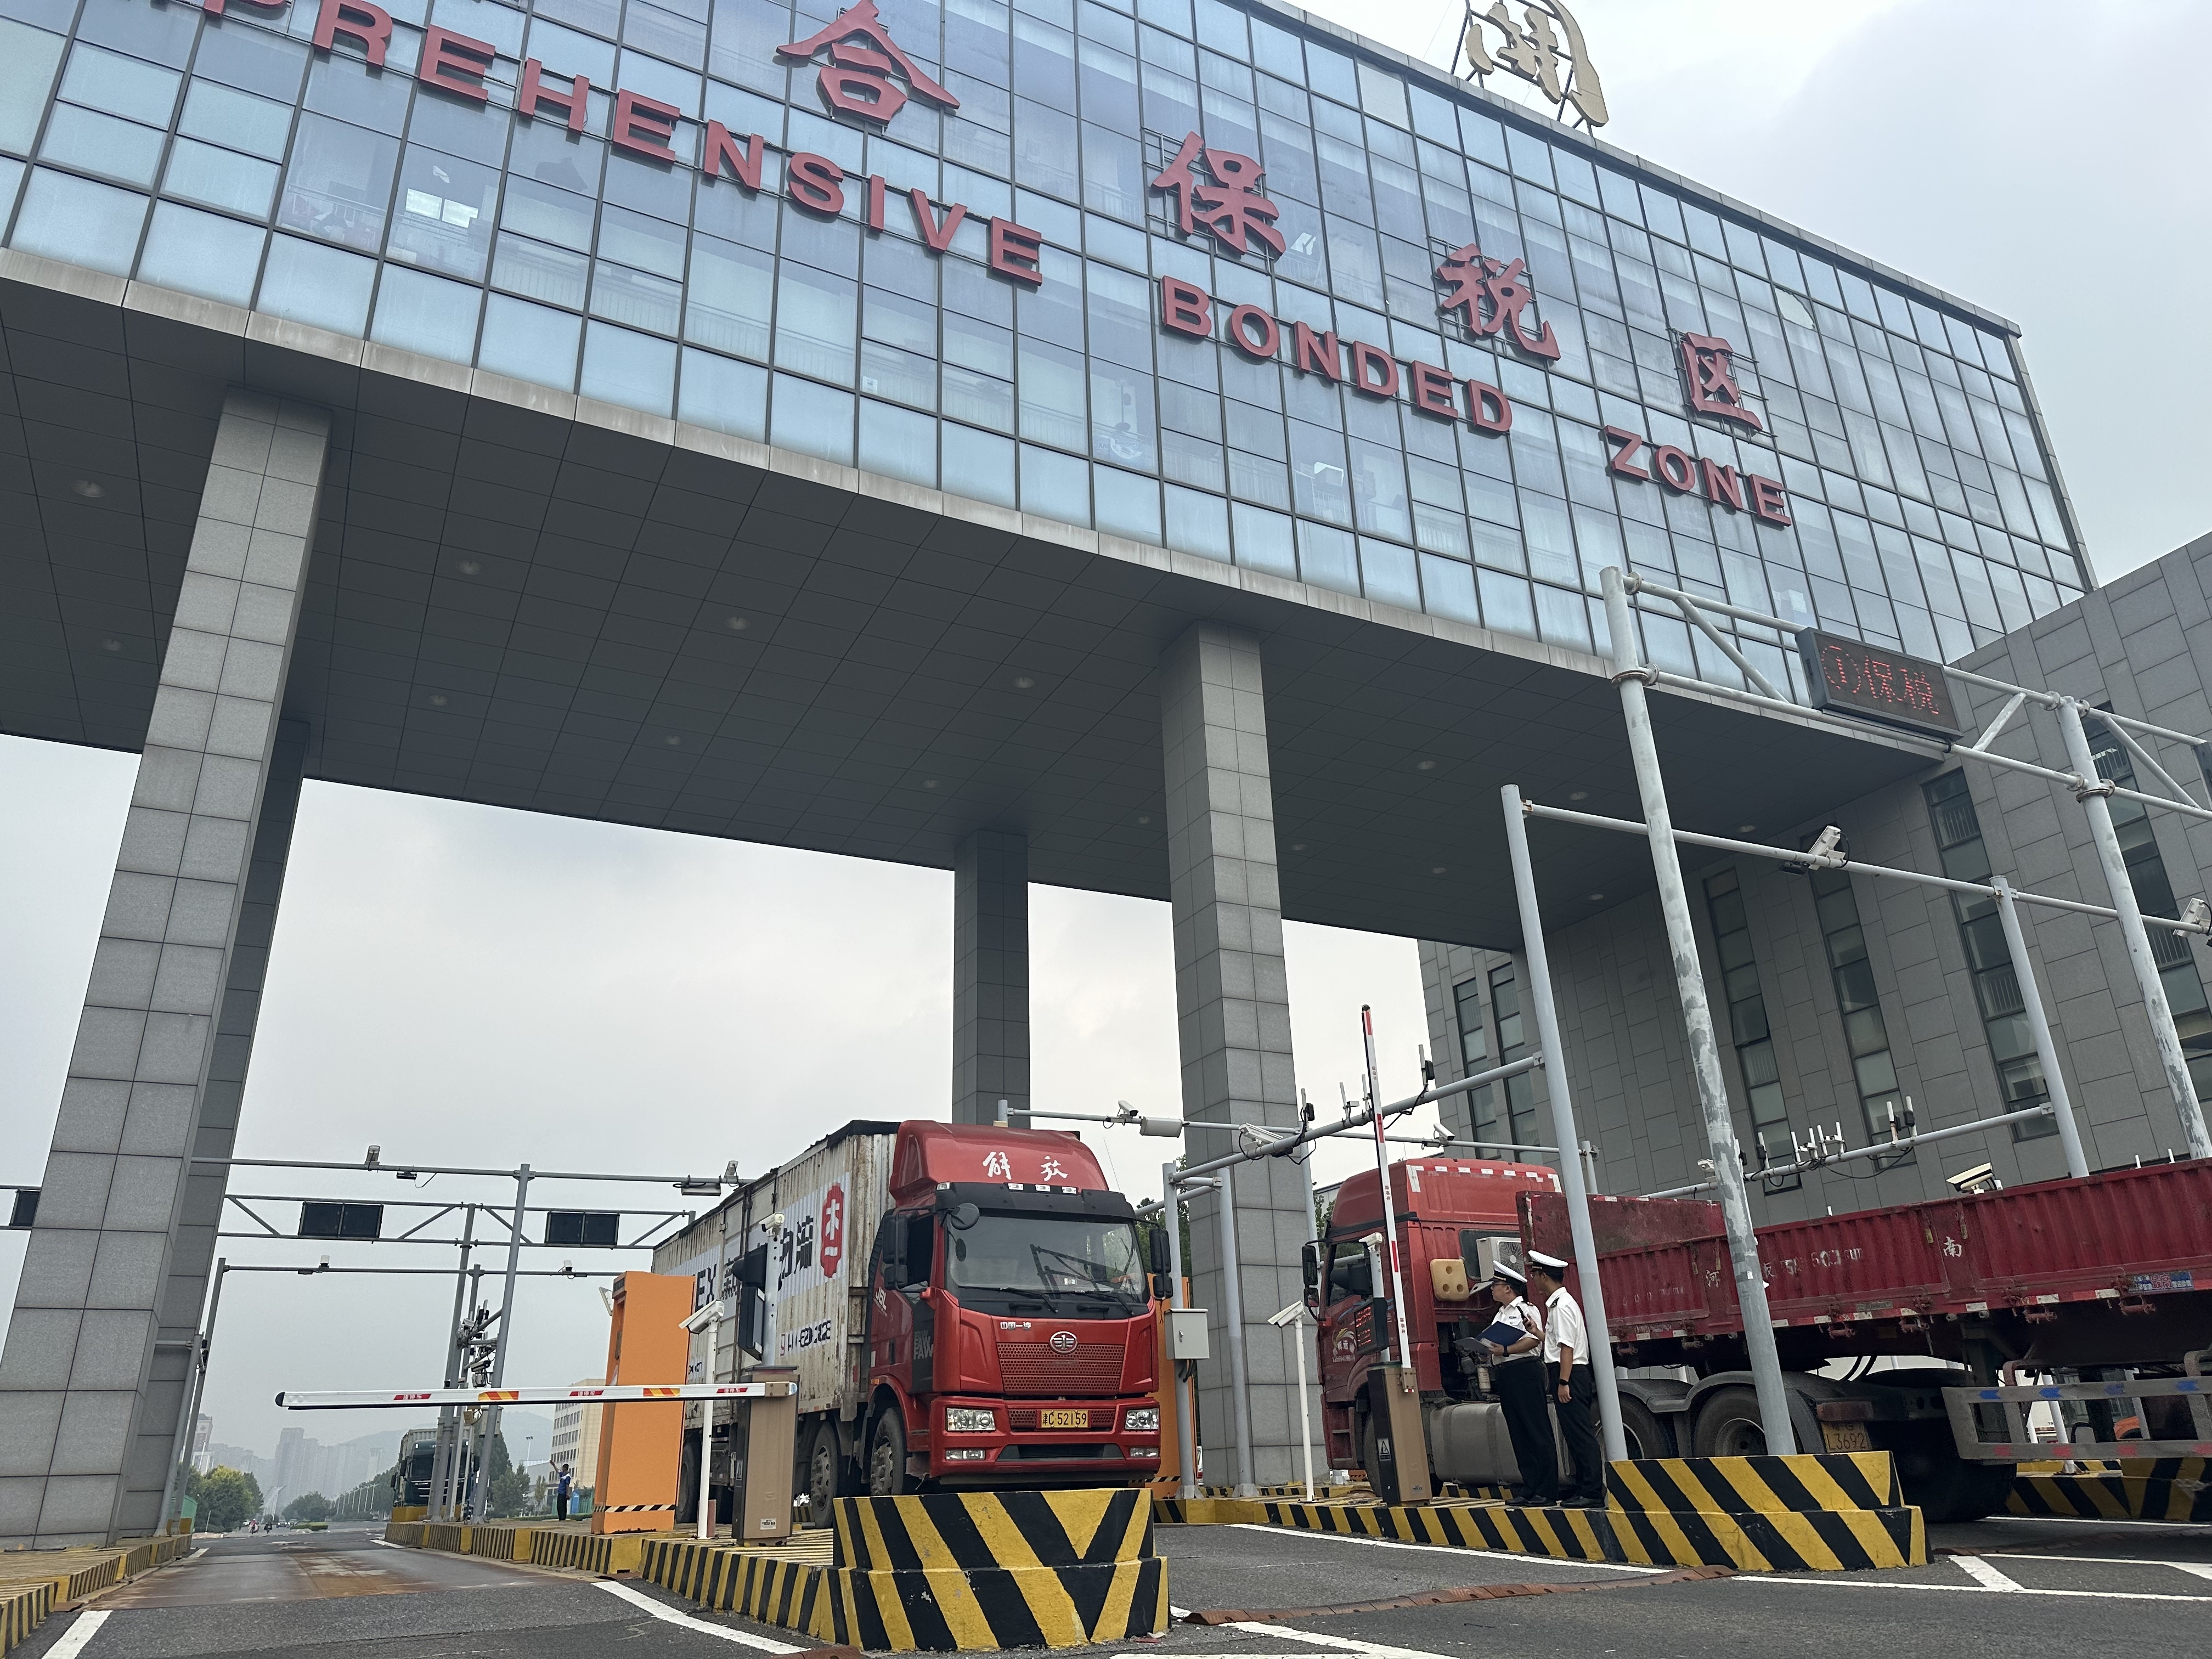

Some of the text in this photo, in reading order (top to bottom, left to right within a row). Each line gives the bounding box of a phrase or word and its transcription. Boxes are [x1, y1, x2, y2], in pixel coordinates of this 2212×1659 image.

[204, 0, 1792, 527] REHENSIVE BONDED ZONE
[983, 1152, 1068, 1182] 解放
[1943, 1237, 1962, 1258] 南
[913, 1344, 934, 1360] FAW
